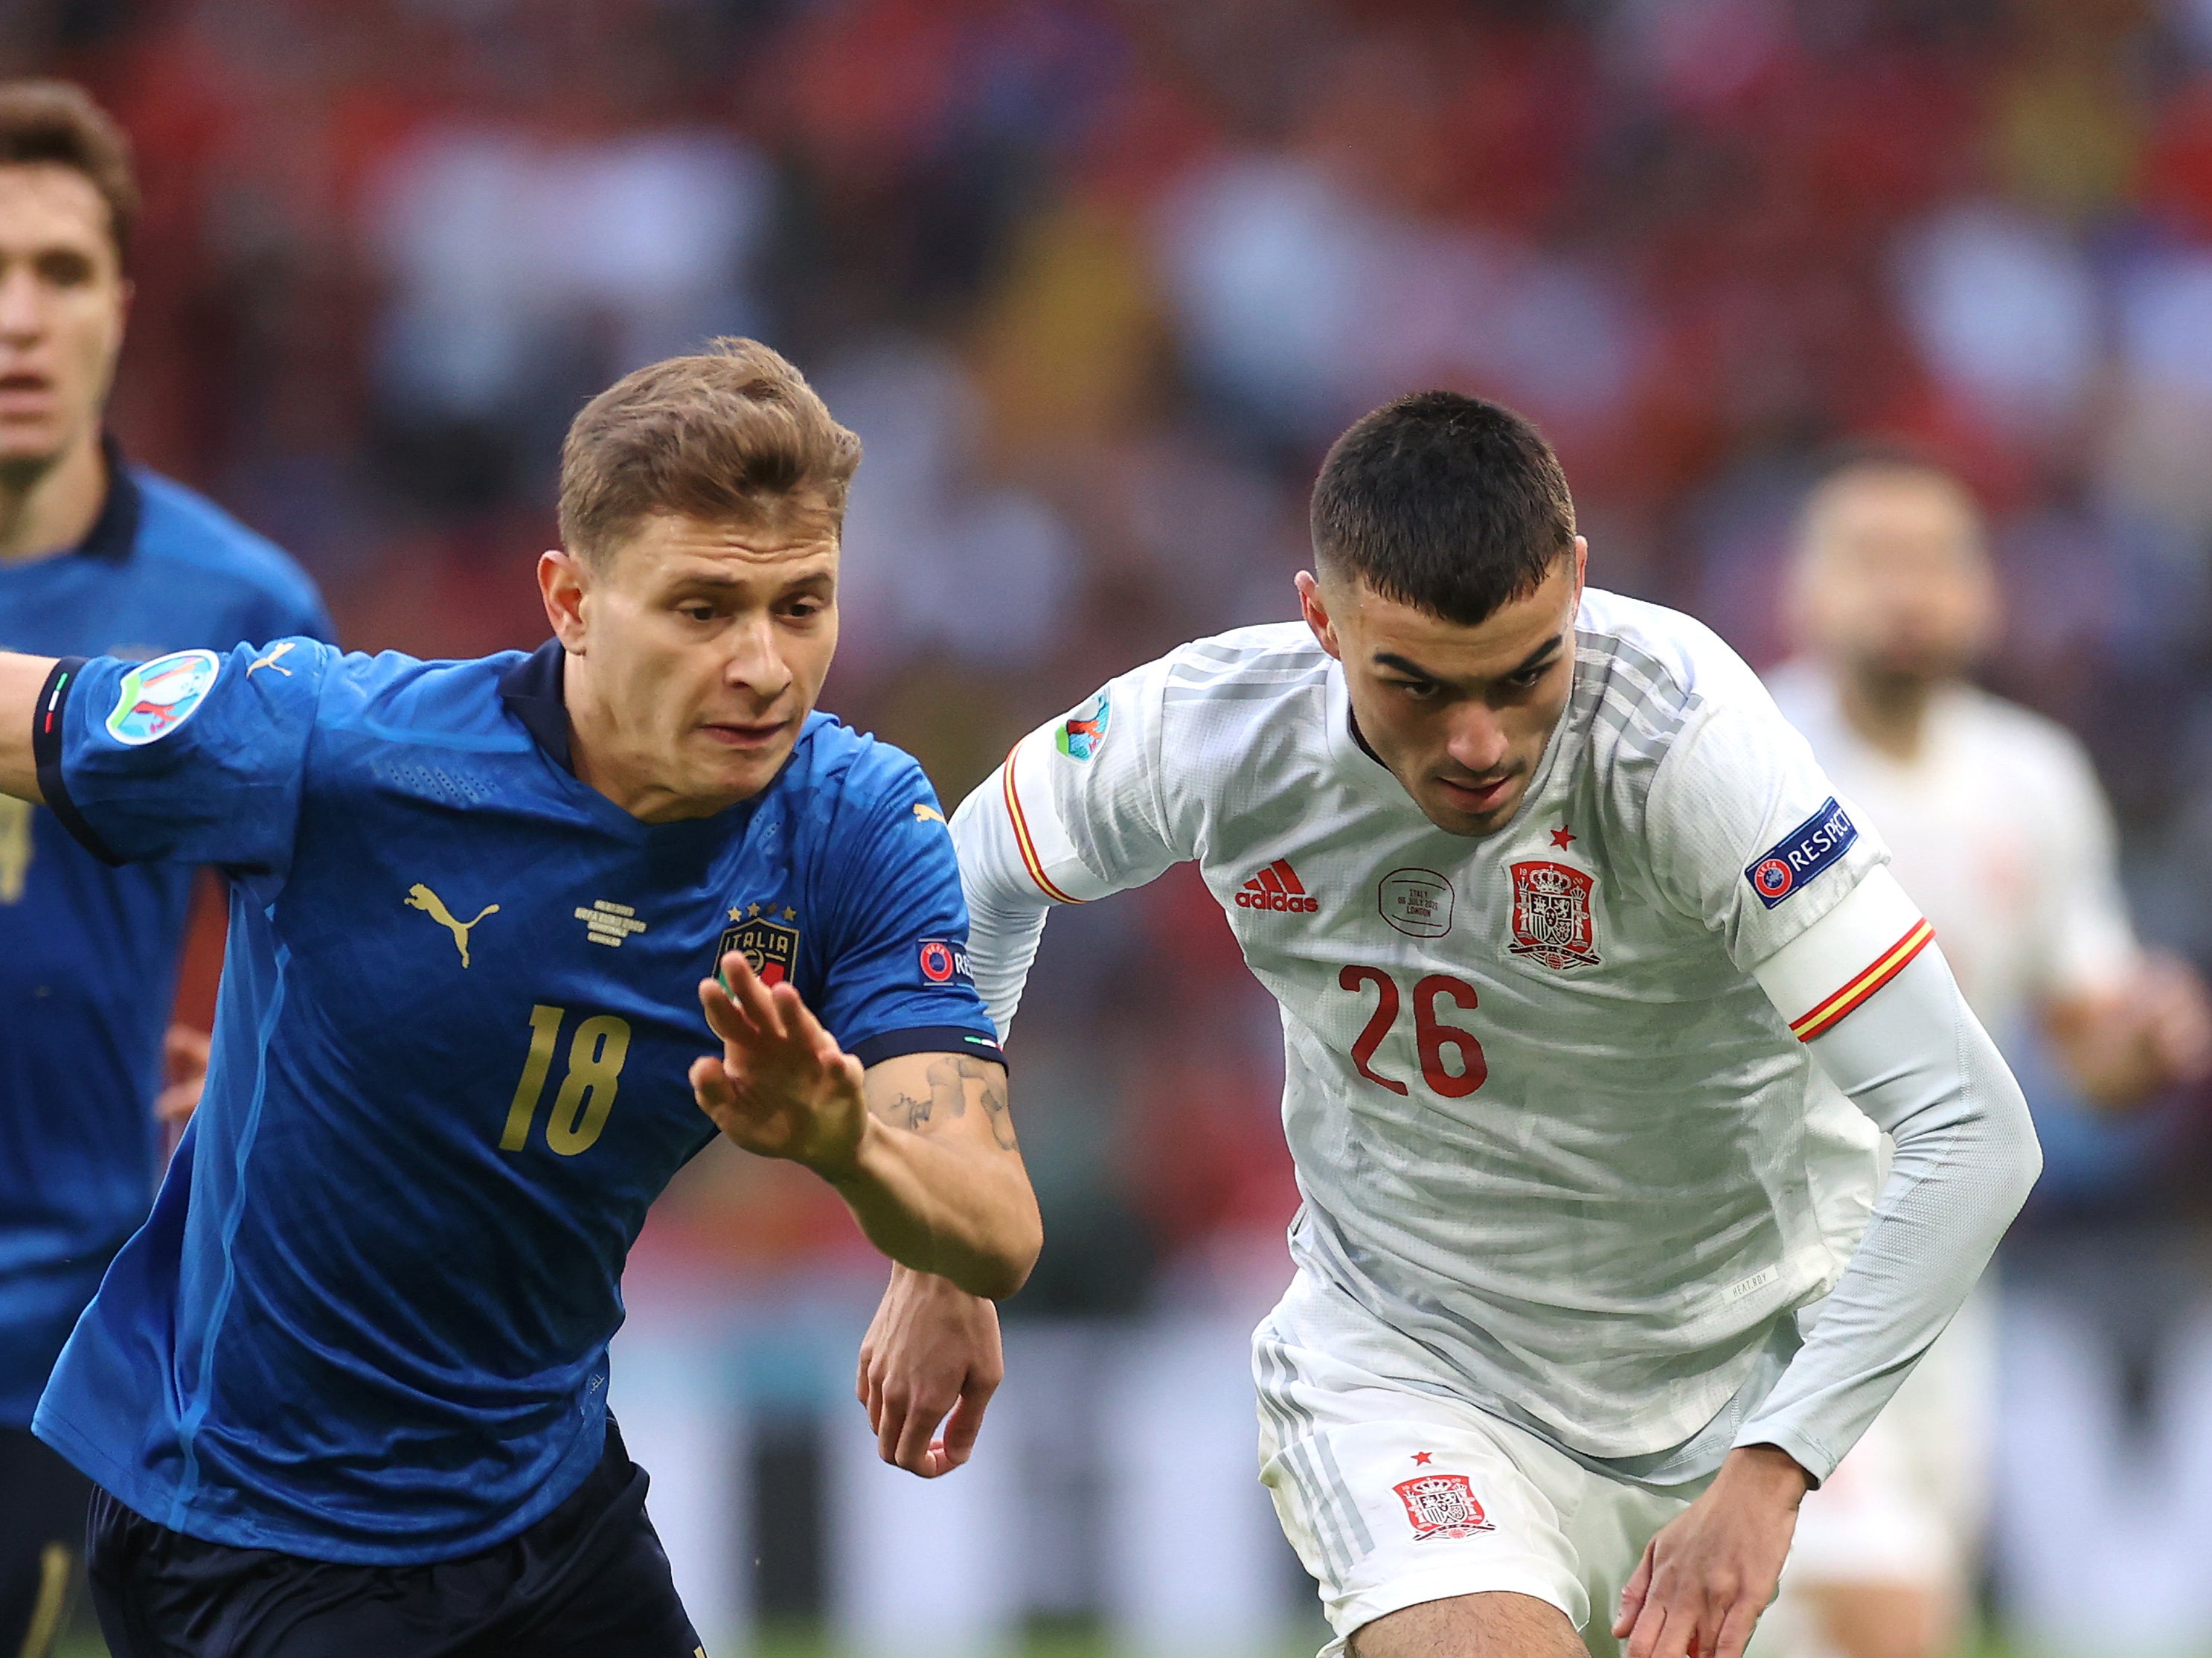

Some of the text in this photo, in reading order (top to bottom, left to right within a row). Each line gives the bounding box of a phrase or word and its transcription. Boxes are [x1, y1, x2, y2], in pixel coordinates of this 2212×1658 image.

[1787, 807, 1851, 872] RESPECT
[1757, 861, 1777, 878] UEFA
[1235, 889, 1318, 912] adidas
[1409, 889, 1428, 898] ITALY
[1407, 906, 1431, 917] LONDON
[725, 931, 789, 953] ITALIA
[1339, 964, 1488, 1098] 26
[498, 1005, 631, 1156] 18
[1732, 1273, 1767, 1297] HEAT.RDY
